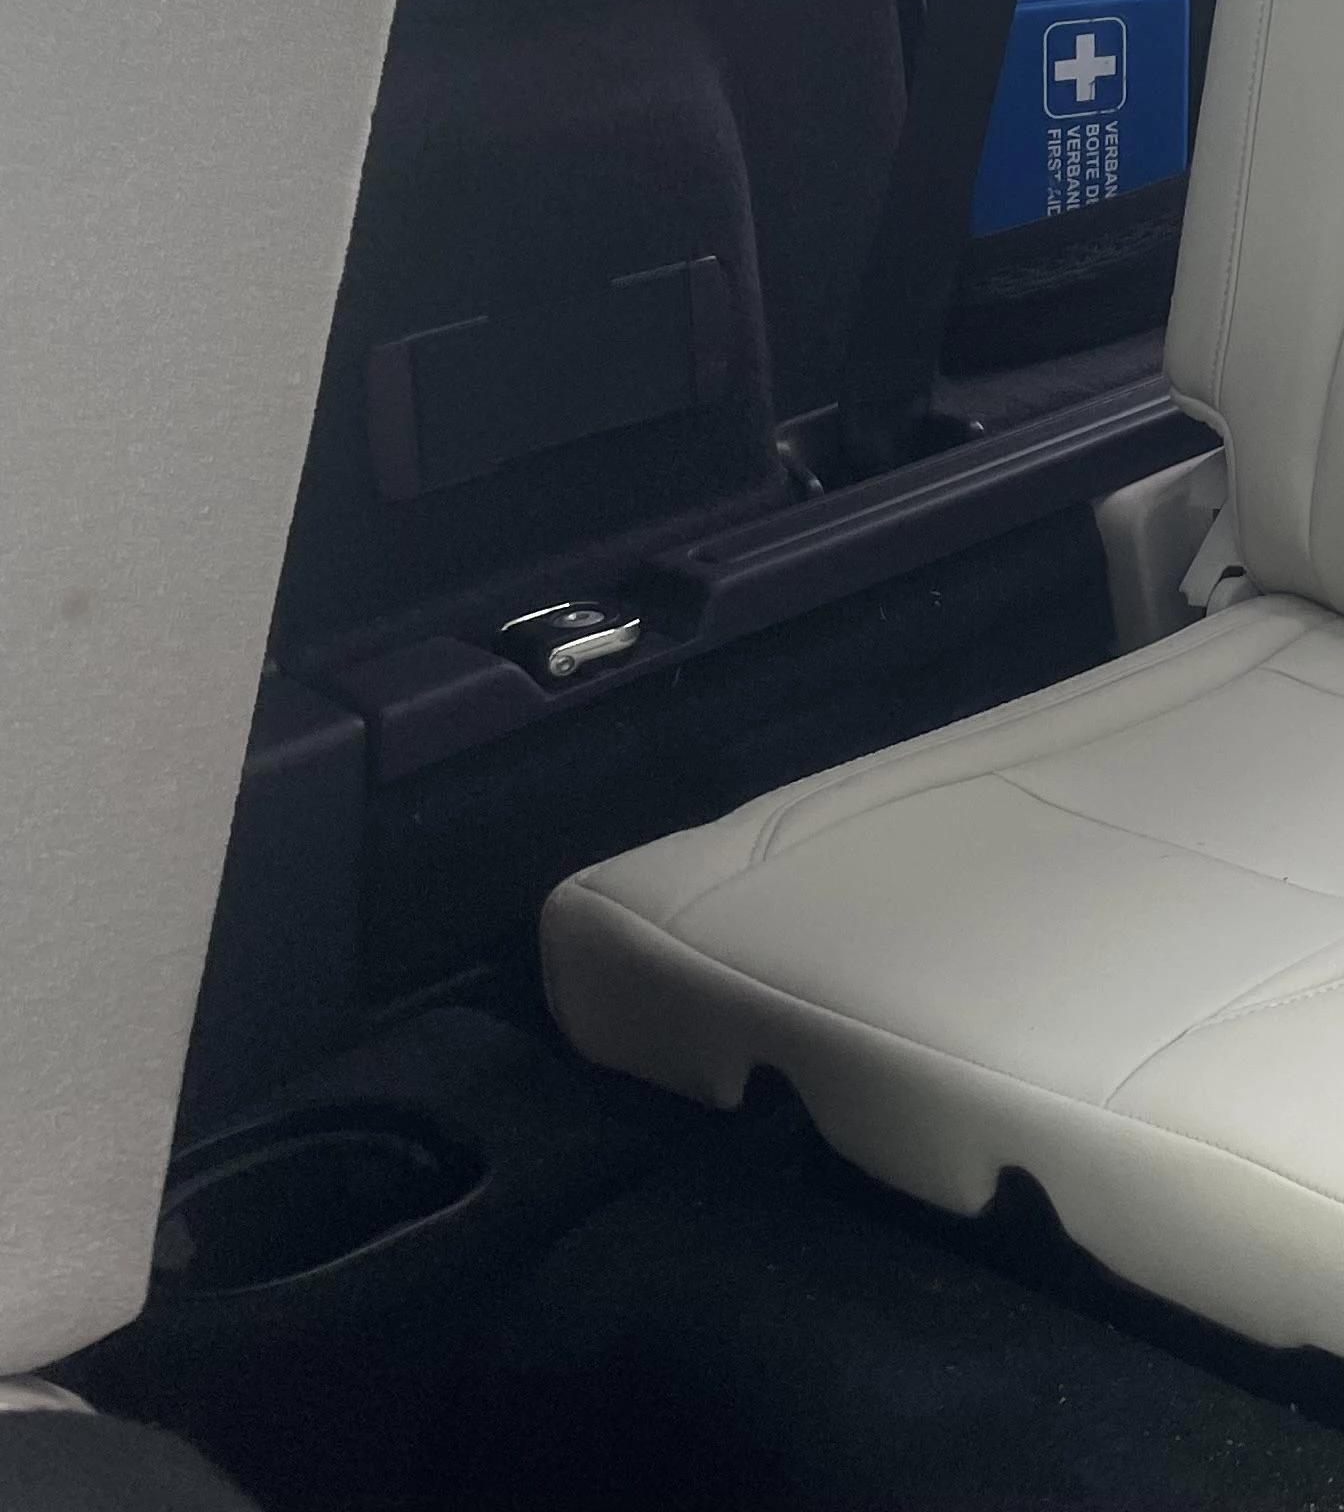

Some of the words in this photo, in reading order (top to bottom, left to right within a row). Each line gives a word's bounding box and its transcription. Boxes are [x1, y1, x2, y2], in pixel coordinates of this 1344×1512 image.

[1047, 128, 1062, 182] FIRST
[1086, 123, 1100, 180] BOITE
[1105, 120, 1119, 199] VERBAN
